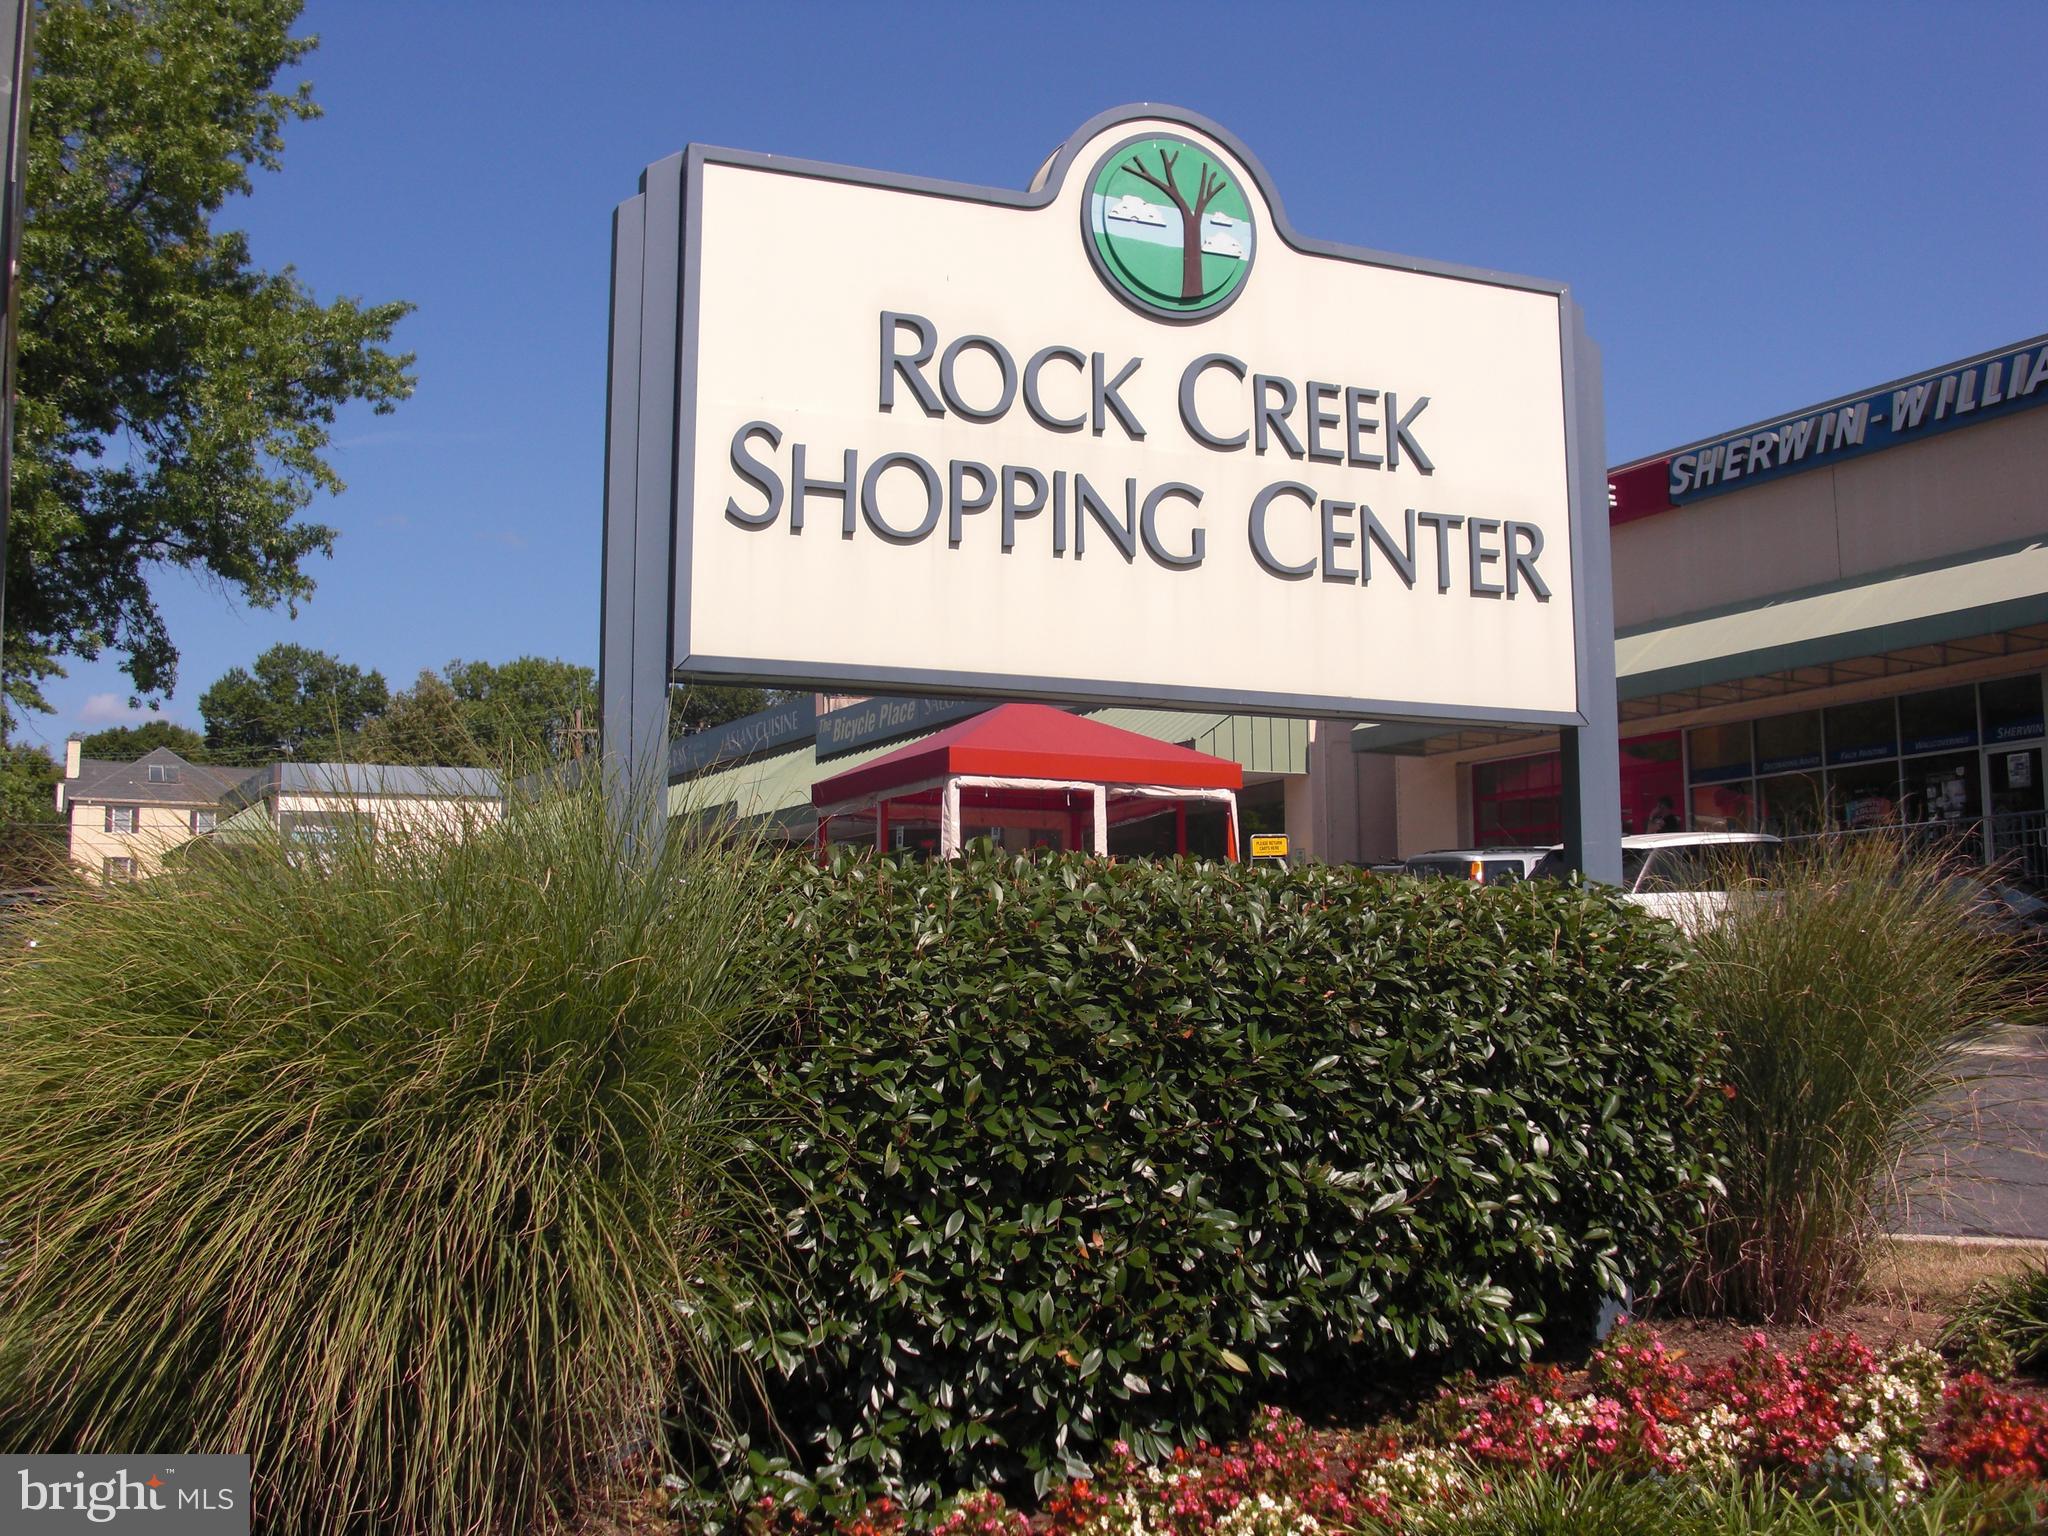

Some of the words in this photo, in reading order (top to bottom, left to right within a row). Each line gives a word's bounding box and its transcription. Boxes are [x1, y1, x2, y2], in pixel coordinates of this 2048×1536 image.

[879, 310, 1147, 441] ROCK
[1178, 352, 1435, 475] CREEK
[725, 420, 1206, 569] SHOPPING
[1248, 480, 1553, 602] CENTER
[754, 710, 799, 741] CUISINE
[818, 718, 832, 734] The
[832, 710, 876, 743] Bicycle
[879, 700, 916, 729] Place
